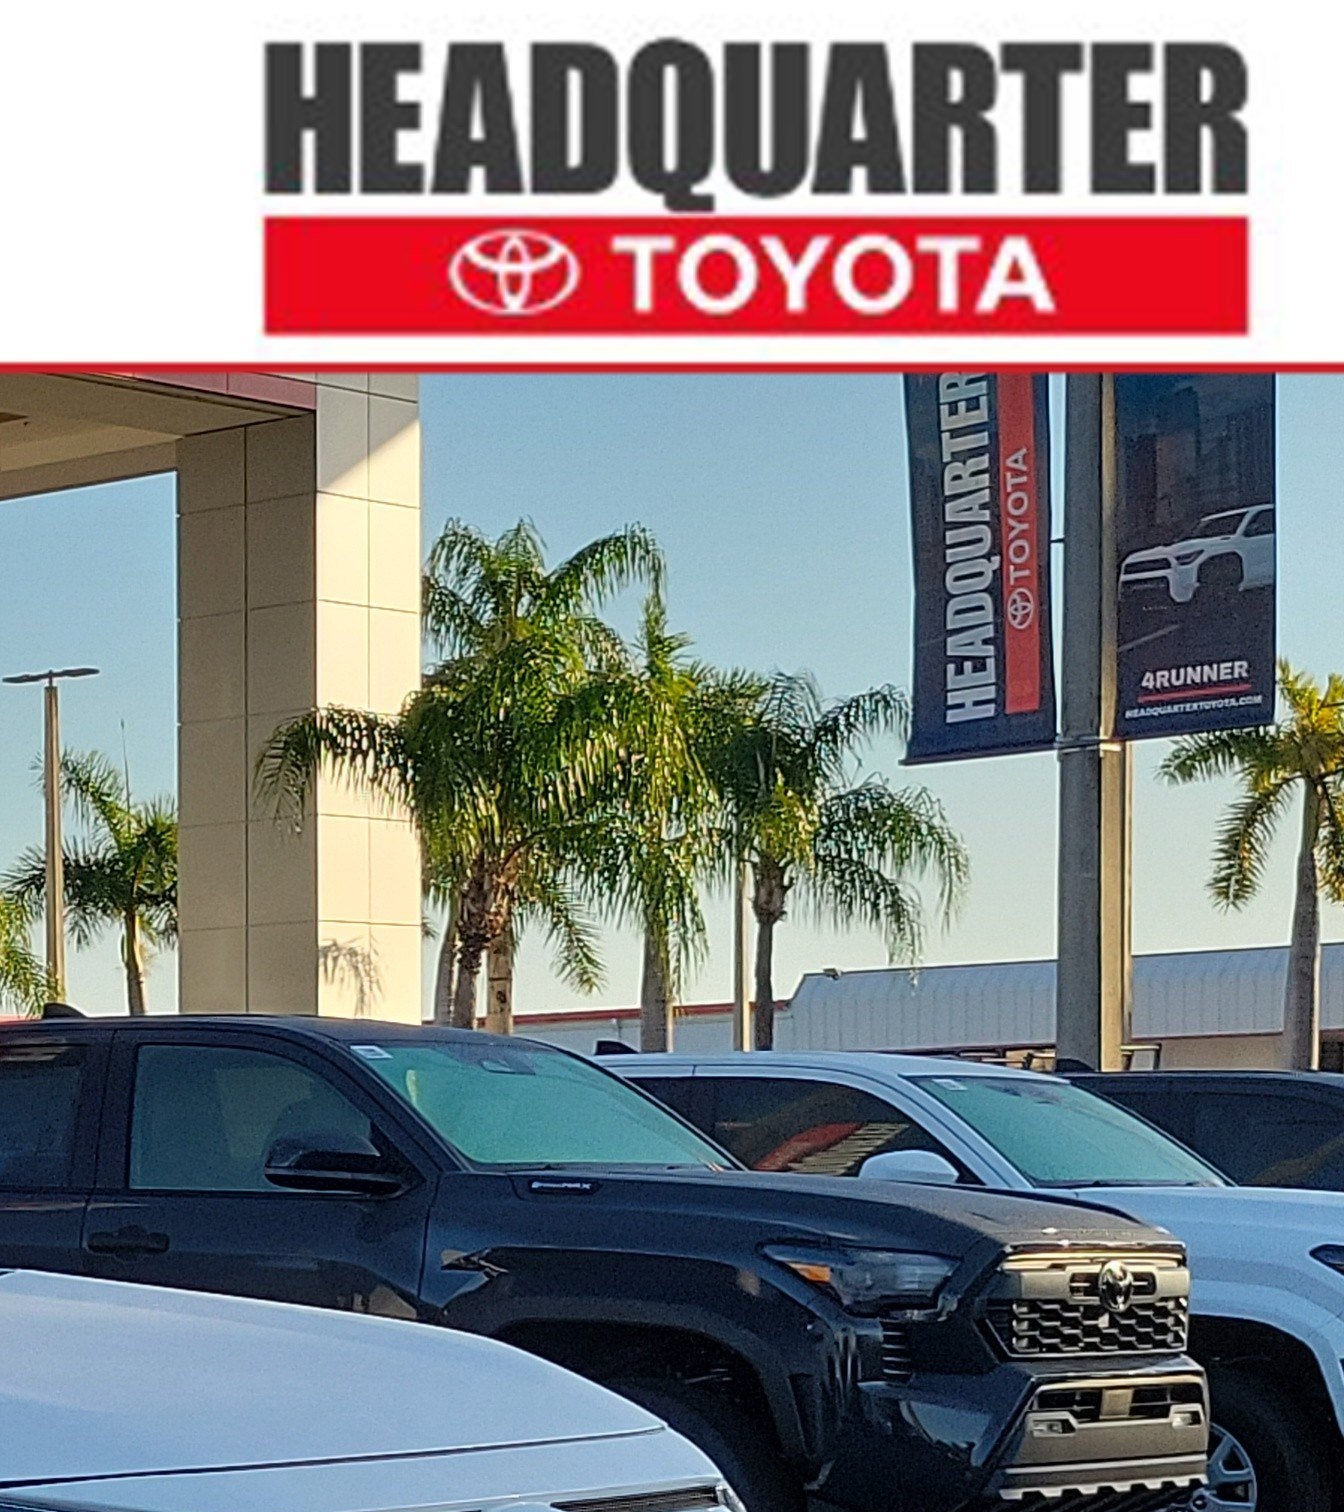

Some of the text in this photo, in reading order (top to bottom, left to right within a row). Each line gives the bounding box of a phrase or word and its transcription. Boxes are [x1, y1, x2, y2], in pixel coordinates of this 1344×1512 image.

[939, 372, 1000, 724] HEADQUARTER
[1005, 447, 1031, 585] TOYOTA
[1124, 695, 1263, 719] HEADQUARTERTOYOTA.COM
[1141, 660, 1250, 690] 4RUNNER
